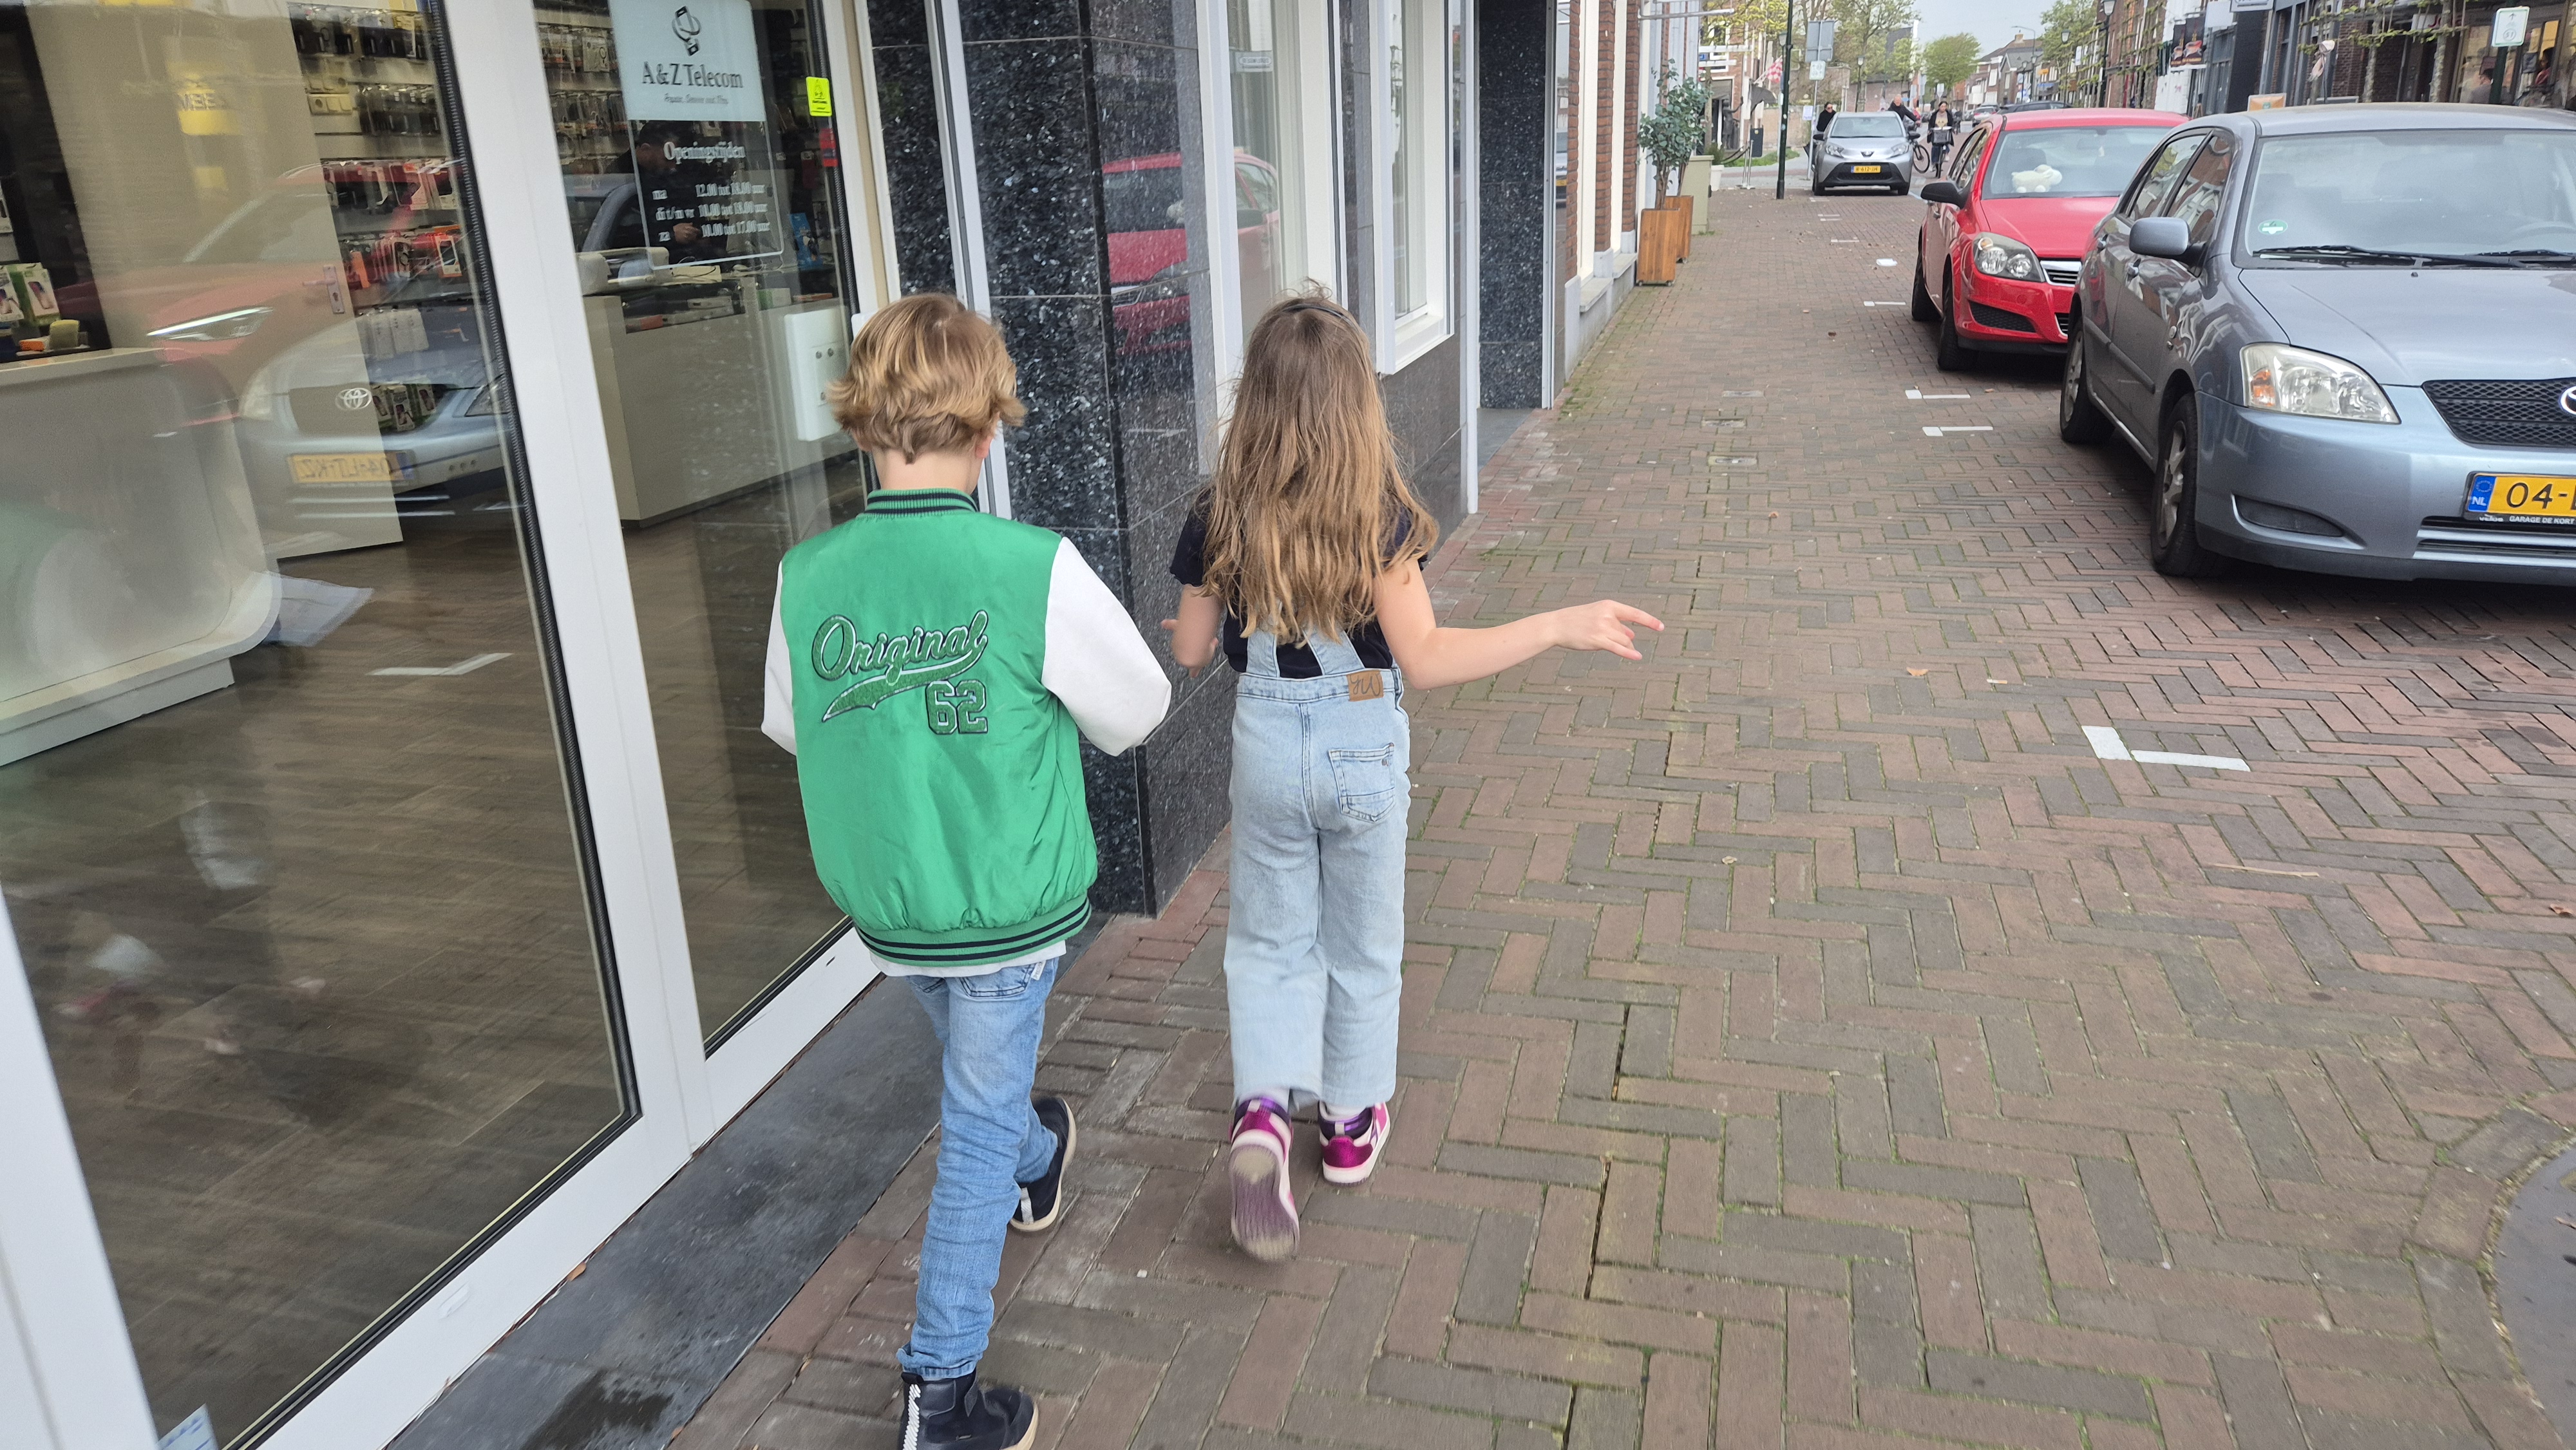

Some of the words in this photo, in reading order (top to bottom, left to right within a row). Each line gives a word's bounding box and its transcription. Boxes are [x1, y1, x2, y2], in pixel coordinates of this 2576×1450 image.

[642, 61, 681, 85] A&Z
[683, 64, 743, 88] Telecom
[663, 141, 746, 164] Openingstijden
[2472, 496, 2486, 506] NL
[2506, 482, 2576, 511] 04-
[2509, 515, 2541, 523] GARAGE
[811, 610, 989, 686] Original
[925, 679, 989, 735] 62
